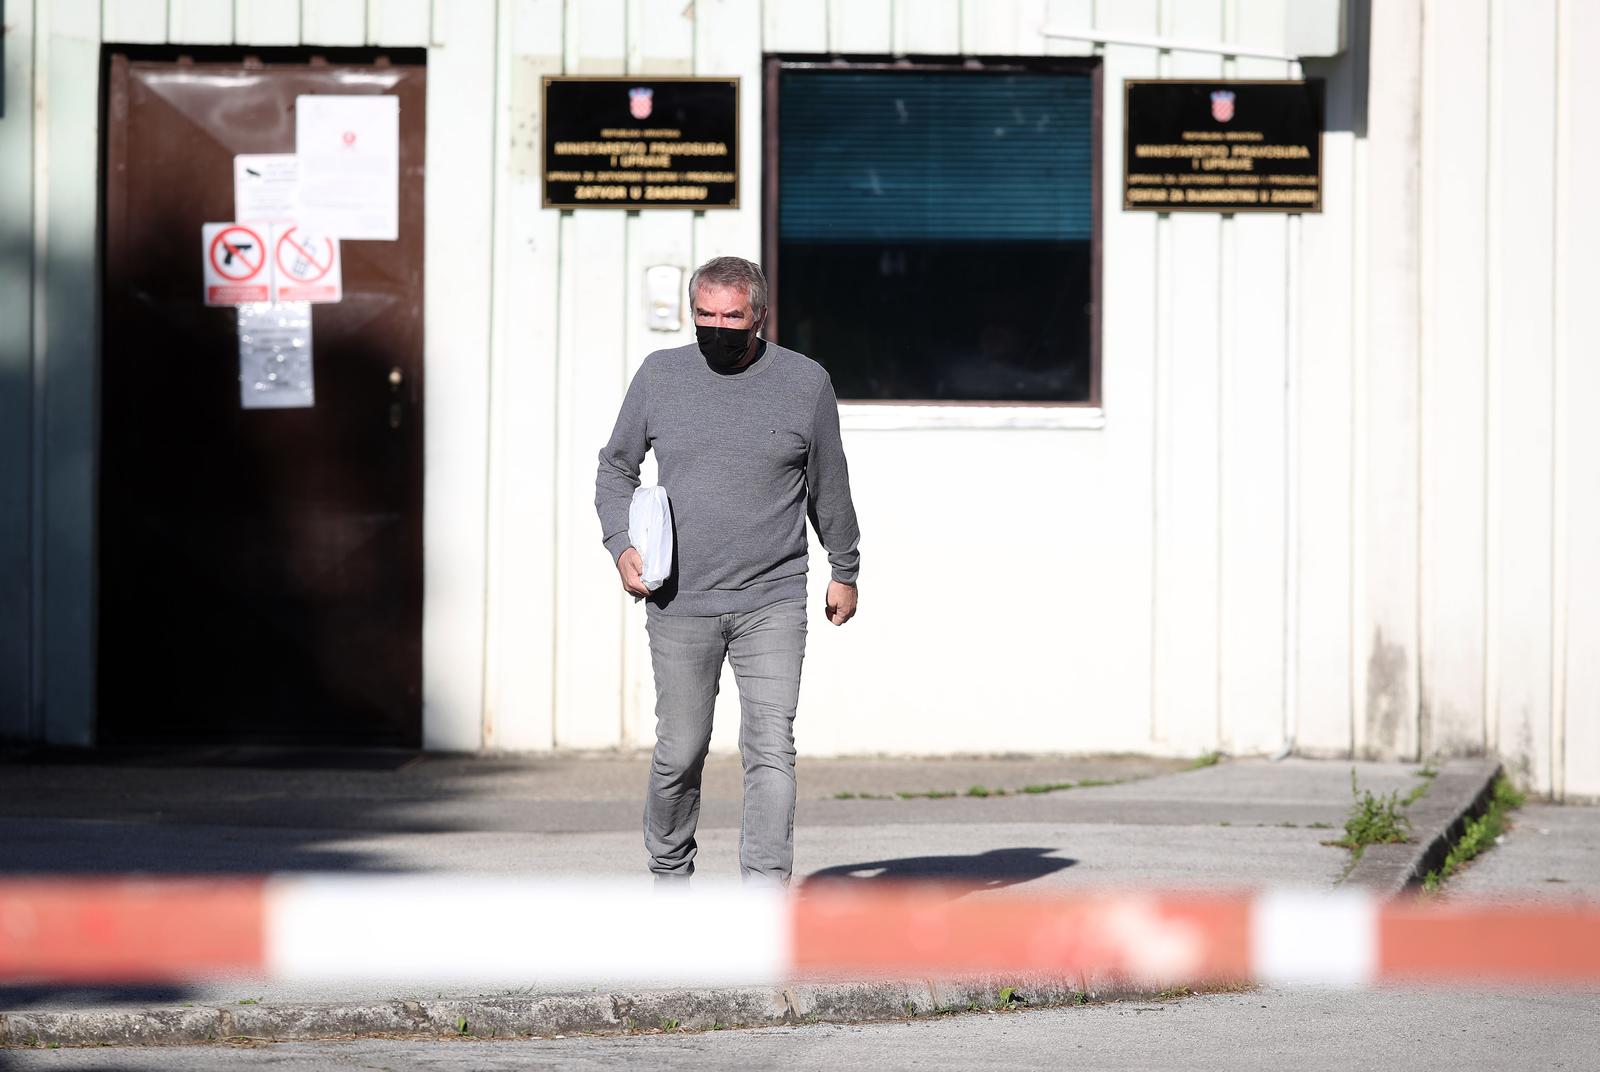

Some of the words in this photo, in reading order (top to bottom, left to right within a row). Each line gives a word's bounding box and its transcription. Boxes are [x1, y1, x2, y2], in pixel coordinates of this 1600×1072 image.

[554, 142, 647, 155] MINISTARSTVO
[1135, 144, 1229, 158] MINISTARSTVO
[620, 154, 671, 168] UPRAVE
[1201, 156, 1253, 170] UPRAVE
[575, 186, 627, 200] ZATVOR
[629, 186, 642, 200] U
[644, 186, 708, 200] ZAGREBU
